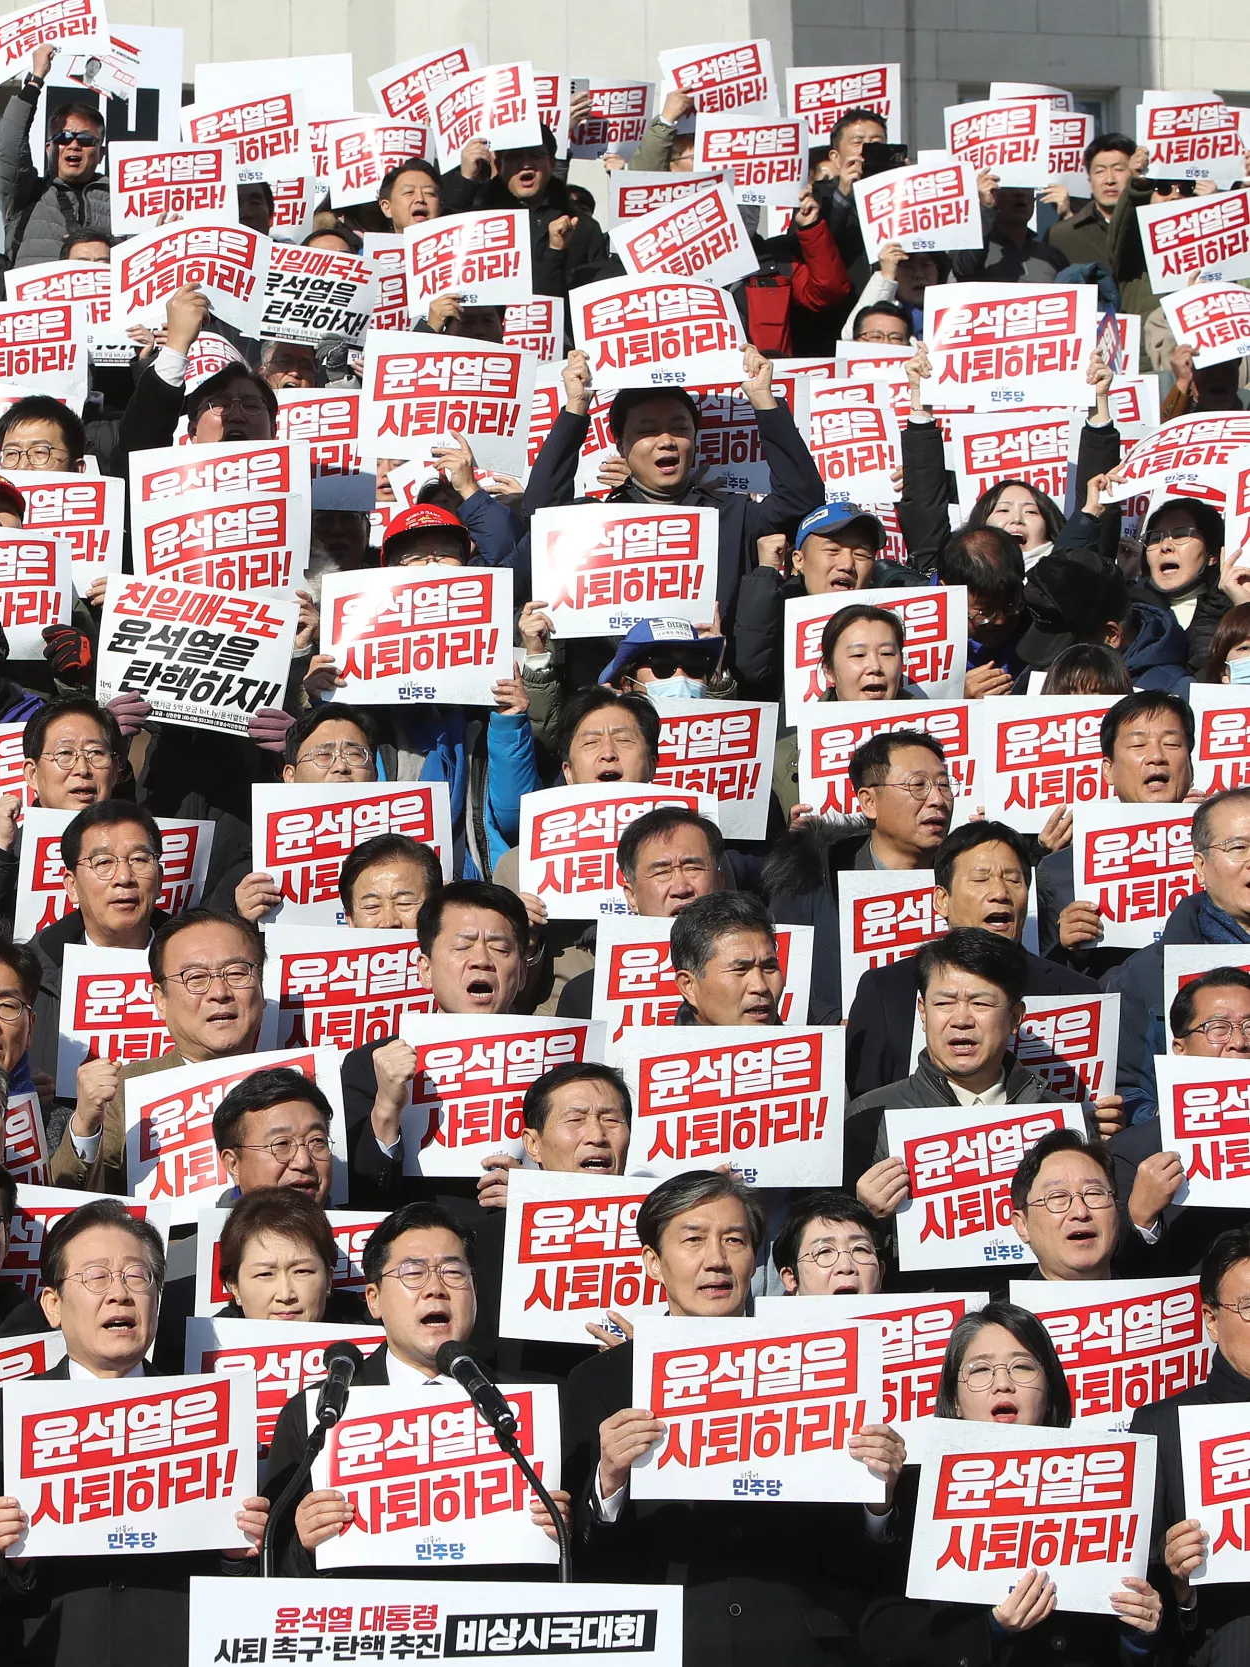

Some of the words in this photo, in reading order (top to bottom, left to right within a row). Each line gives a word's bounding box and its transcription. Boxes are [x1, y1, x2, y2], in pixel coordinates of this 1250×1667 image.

[7, 17, 96, 64] 사퇴하라!
[678, 48, 757, 89] 윤석열은
[800, 72, 881, 109] 윤석열은
[196, 98, 288, 141] 윤석열은
[954, 109, 1030, 149] 윤석열은
[1153, 106, 1234, 132] 윤석열은
[708, 128, 796, 158] 윤석열은
[124, 154, 216, 188] 윤석열은
[125, 186, 226, 217] 사퇴하라!
[629, 199, 720, 263] 윤석열은
[1155, 199, 1244, 249] 윤석열은
[128, 230, 248, 284] 윤석열은
[262, 300, 370, 336] 탄핵하자!
[592, 288, 719, 333] 윤석열은
[943, 298, 1072, 344] 윤석열은
[596, 322, 736, 370] 사퇴하라!
[939, 339, 1081, 384] 사퇴하라!
[383, 357, 512, 394] 윤석열은
[650, 371, 686, 383] 민주당
[991, 390, 1025, 402] 민주당
[378, 401, 520, 437] 사퇴하라!
[150, 504, 282, 559] 윤석열은
[554, 565, 704, 609] 사퇴하라!
[113, 582, 285, 639] 친일매국노
[107, 618, 260, 671] 윤석열을
[339, 629, 498, 680] 사퇴하라!
[118, 660, 282, 712] 탄핵하자!
[398, 686, 436, 699] 민주당
[649, 1042, 811, 1107] 윤석열은
[648, 1097, 828, 1160] 사퇴하라!
[984, 1244, 1024, 1261] 민주당
[663, 1338, 847, 1408] 윤석열은
[32, 1391, 218, 1468] 윤석열은
[658, 1400, 871, 1468] 사퇴하라!
[31, 1450, 238, 1526] 사퇴하라!
[732, 1479, 783, 1496] 민주당
[947, 1451, 1124, 1510] 윤석열은
[107, 1532, 157, 1549] 민주당
[416, 1543, 465, 1560] 민주당
[937, 1515, 1138, 1571] 사퇴하라!
[276, 1607, 354, 1634] 윤석열
[360, 1605, 438, 1633] 대통령
[456, 1615, 645, 1651] 비상시국대회
[214, 1637, 266, 1663] 사퇴
[390, 1633, 441, 1659] 추진
